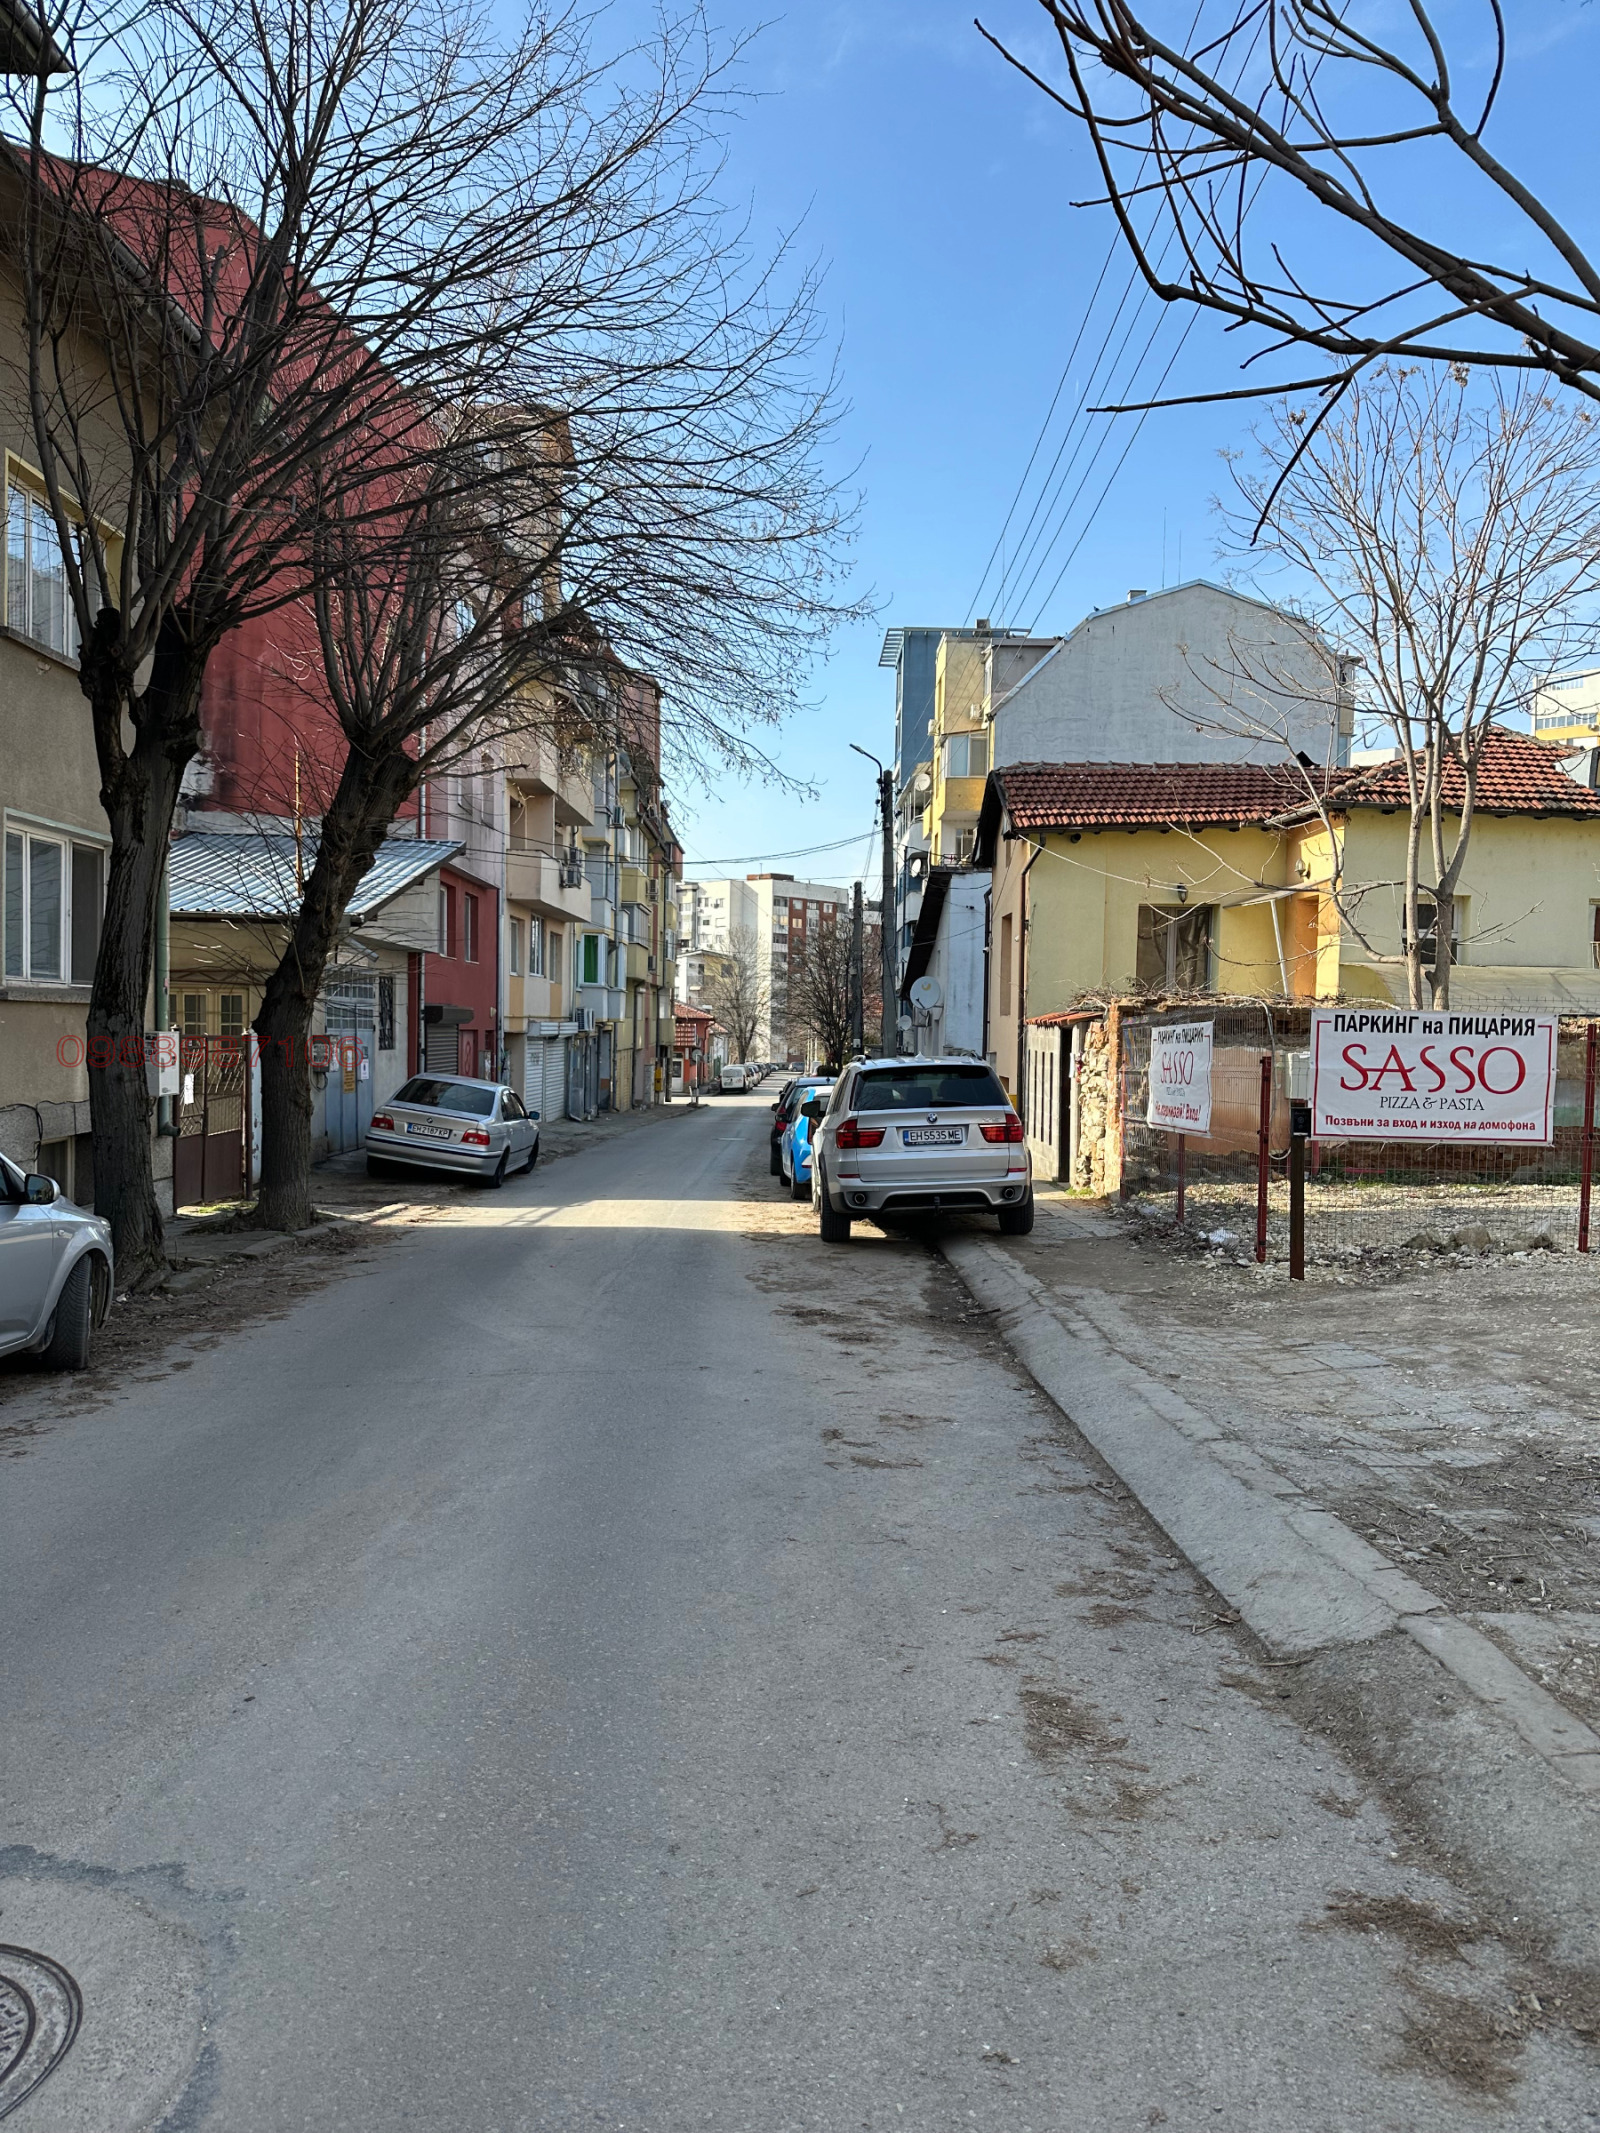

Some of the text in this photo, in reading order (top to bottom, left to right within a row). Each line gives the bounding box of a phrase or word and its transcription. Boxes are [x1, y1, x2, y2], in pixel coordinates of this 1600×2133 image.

[1333, 1014, 1536, 1039] ПАРКИНГ на ПИЦАРИЯ
[1160, 1050, 1194, 1085] SASSO
[1339, 1043, 1527, 1095] SASSO
[1379, 1096, 1485, 1111] PIZZA & PASTA
[1325, 1115, 1536, 1132] Позвъни за вход и изход на домофона
[910, 1130, 961, 1141] EH 5535 ME
